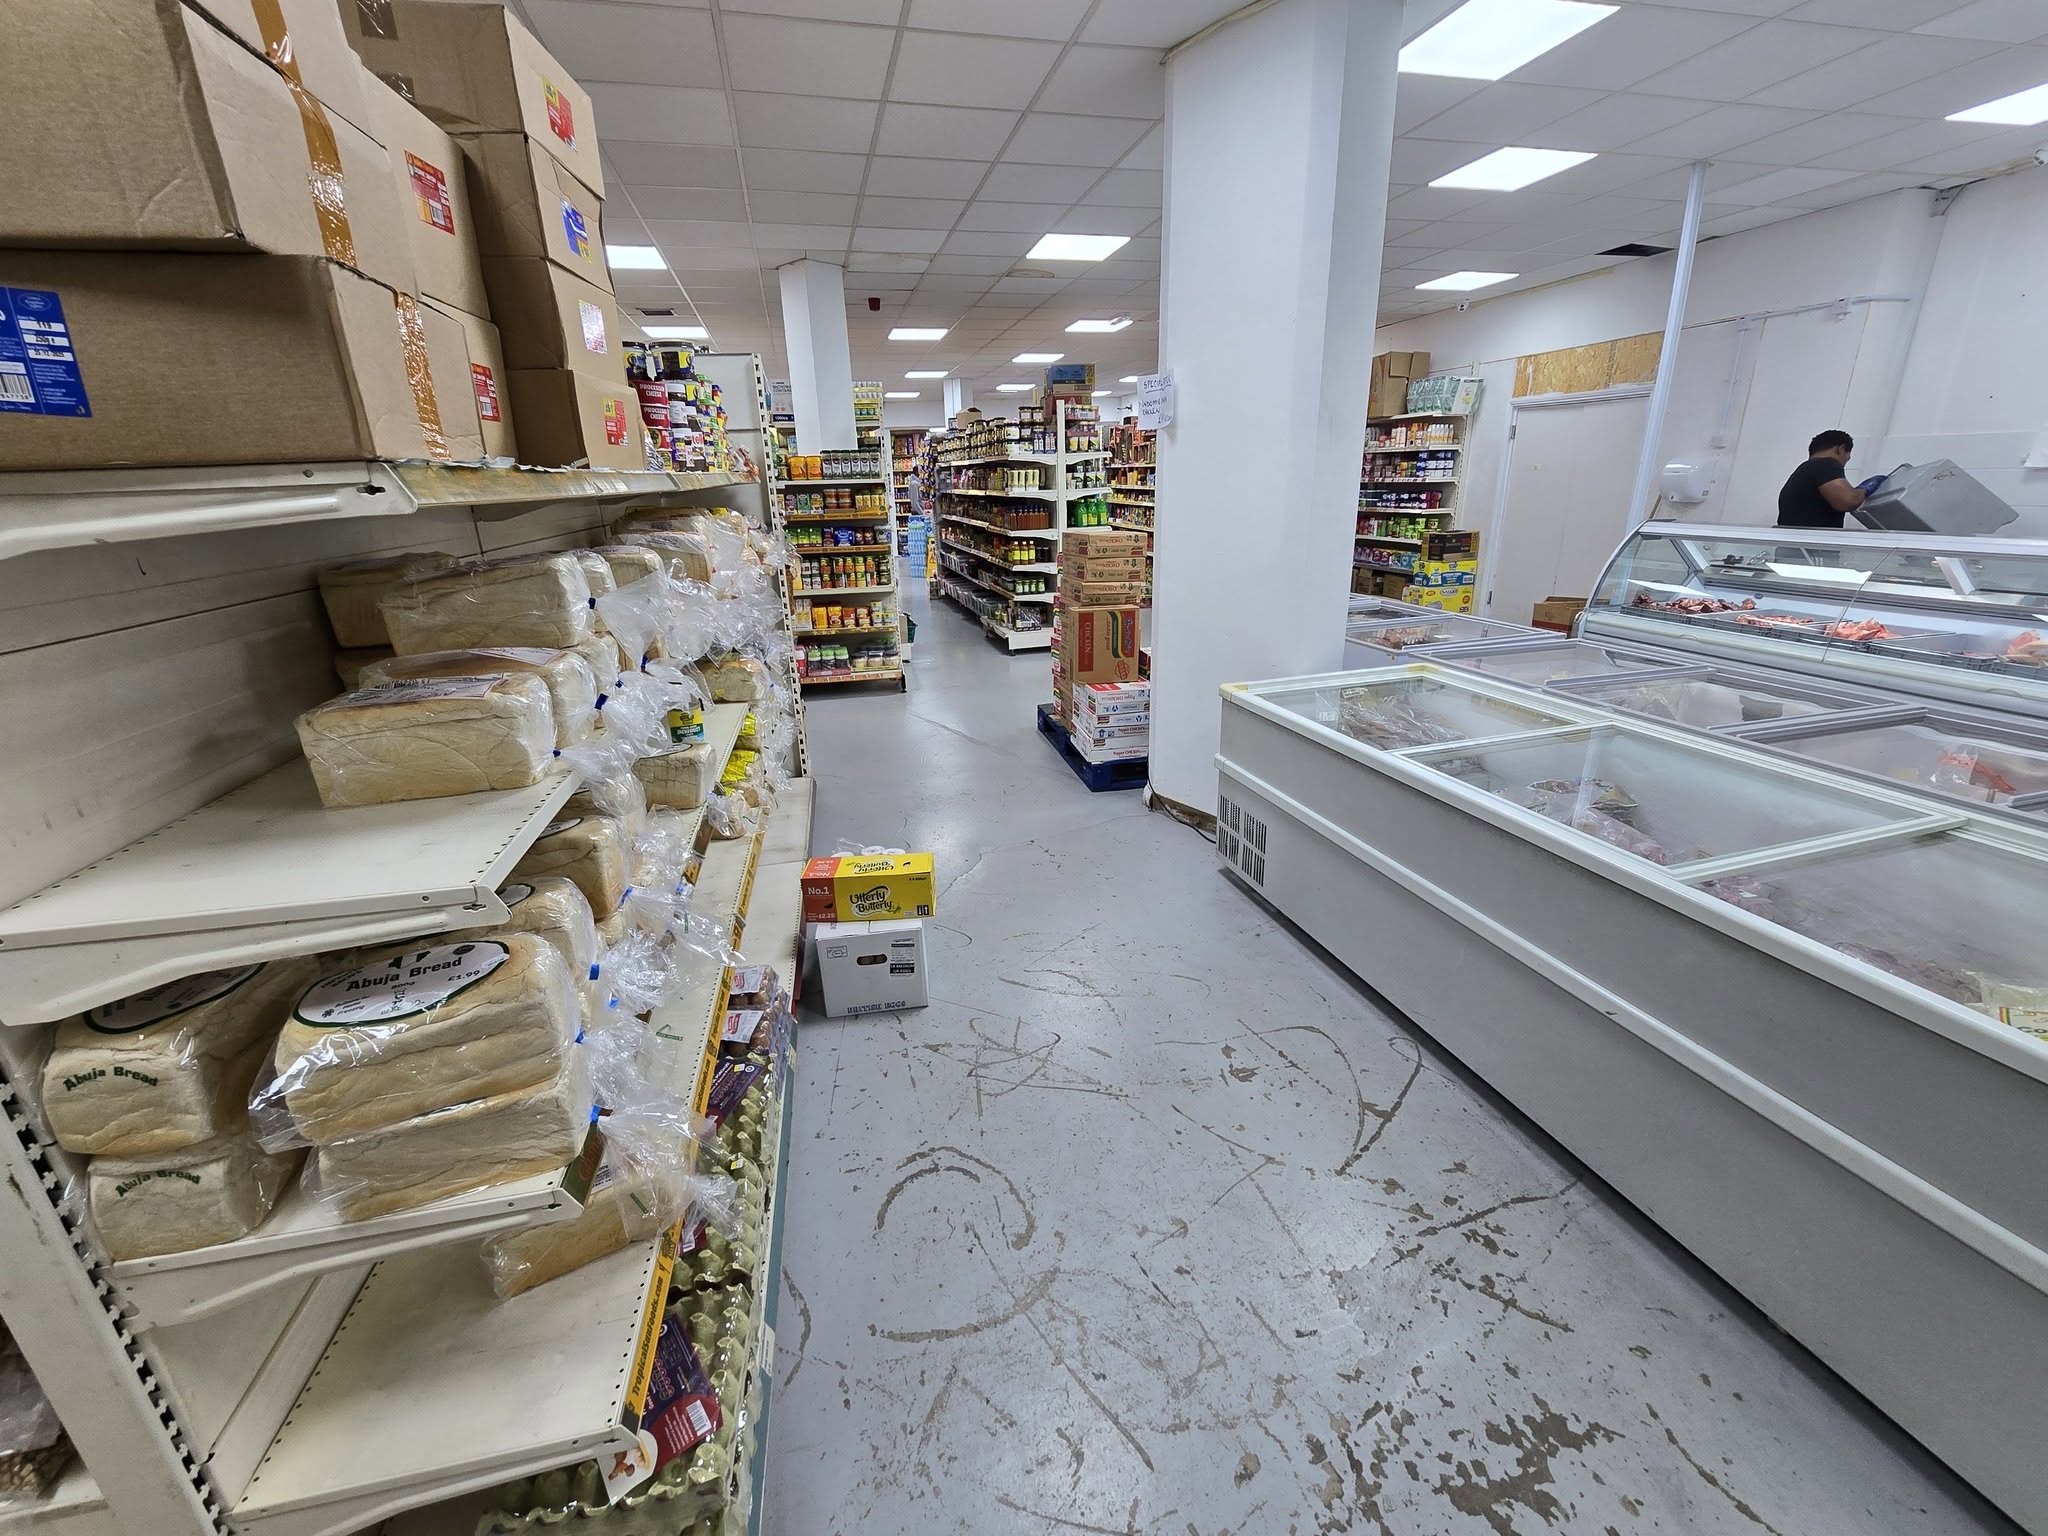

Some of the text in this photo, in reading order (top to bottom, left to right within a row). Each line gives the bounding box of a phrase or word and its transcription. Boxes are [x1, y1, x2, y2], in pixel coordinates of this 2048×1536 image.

[1084, 622, 1092, 653] CHICKEN
[808, 886, 830, 895] No.1
[849, 889, 886, 904] Utterly
[855, 900, 893, 913] Butterly
[345, 973, 400, 992] Abuja
[409, 957, 463, 977] Bread
[447, 969, 481, 982] £1.99
[63, 1066, 159, 1092] Abuja Bread
[115, 1170, 201, 1198] Abuja Bread
[632, 1274, 663, 1397] TropicalSunFoods.com
